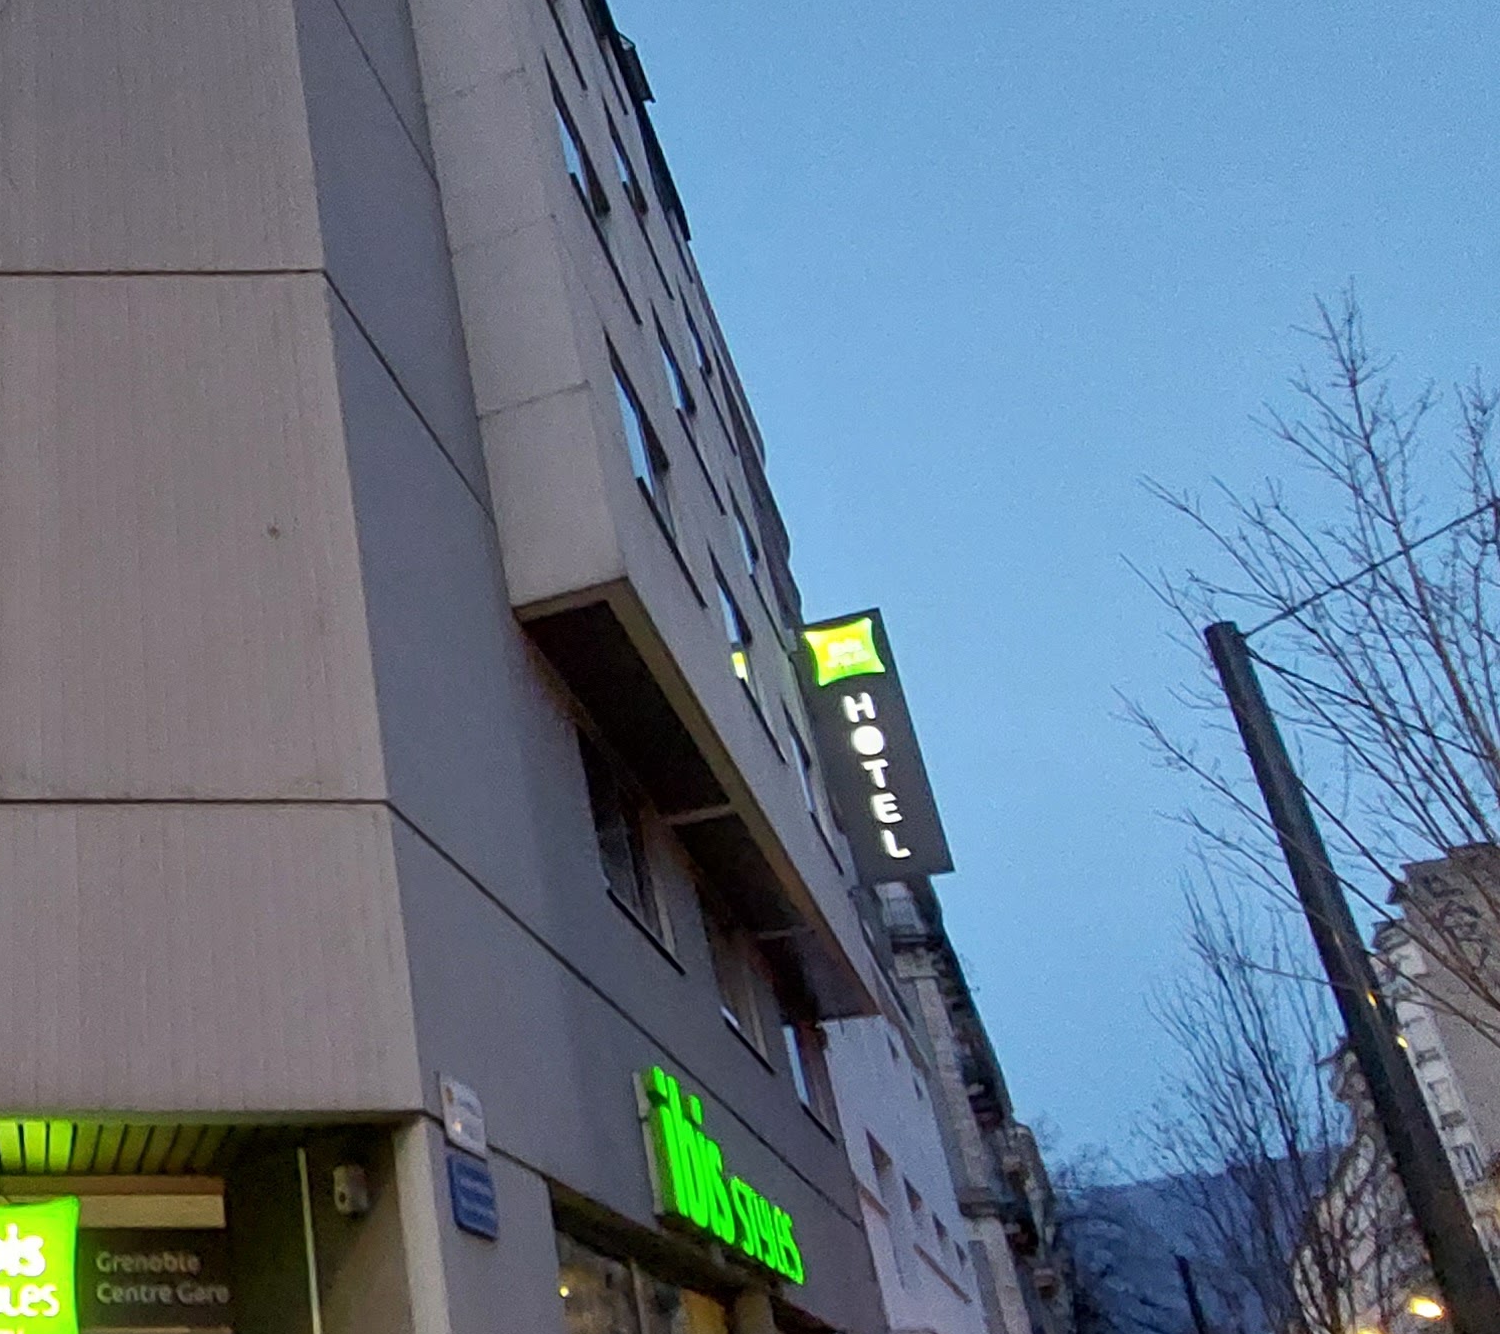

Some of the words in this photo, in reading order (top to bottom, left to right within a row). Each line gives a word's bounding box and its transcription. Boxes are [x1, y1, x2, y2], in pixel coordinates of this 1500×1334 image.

[842, 692, 912, 859] HOTEL
[95, 1250, 202, 1275] Grenoble
[96, 1281, 174, 1305] Centre
[175, 1281, 230, 1305] Gare
